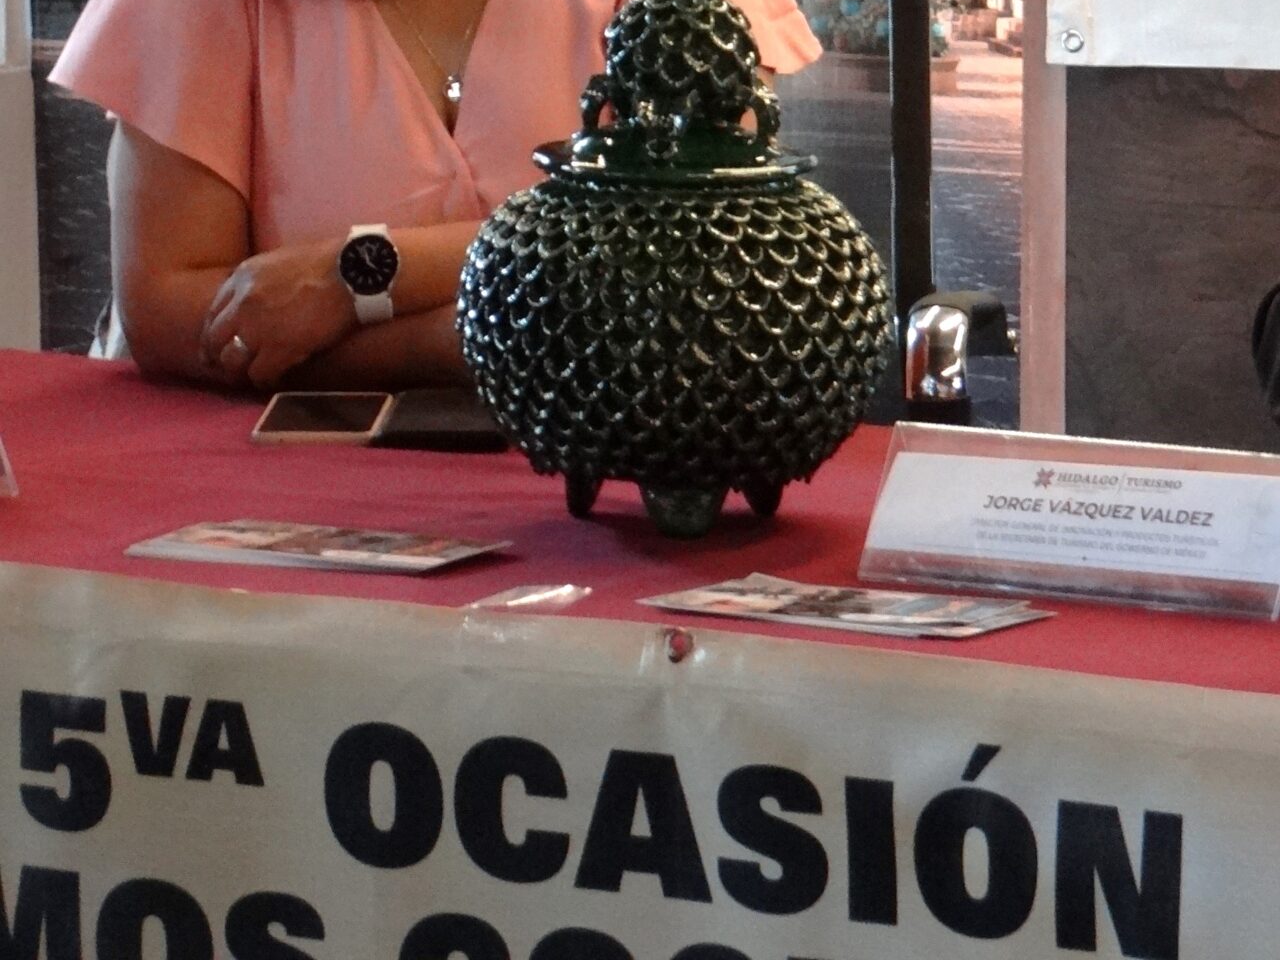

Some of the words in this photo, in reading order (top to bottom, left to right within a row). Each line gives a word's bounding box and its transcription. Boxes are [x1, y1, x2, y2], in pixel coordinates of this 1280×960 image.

[1056, 472, 1119, 487] HIDALGO
[1126, 476, 1183, 490] TURISMO
[982, 494, 1043, 513] JORGE
[1049, 497, 1136, 520] VÁZQUEZ
[1139, 506, 1214, 527] VALDEZ
[323, 721, 1185, 960] OCASIÓN
